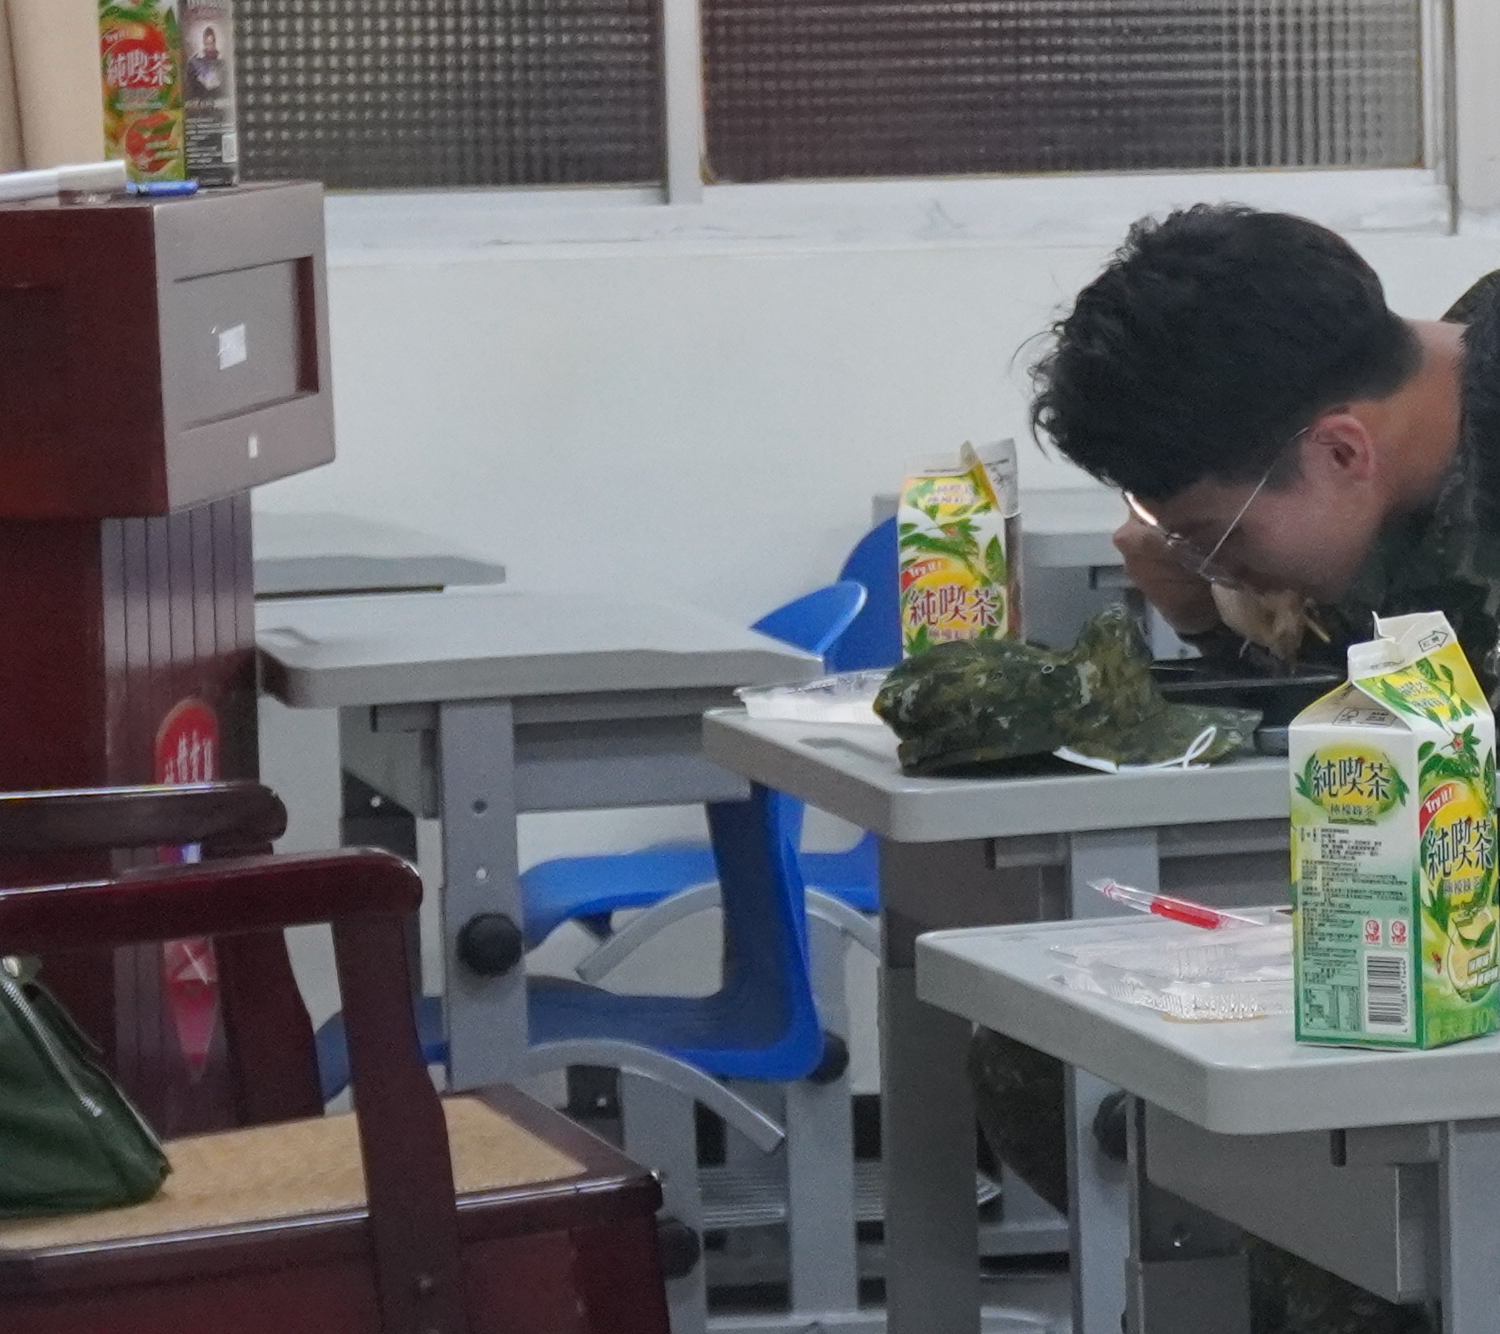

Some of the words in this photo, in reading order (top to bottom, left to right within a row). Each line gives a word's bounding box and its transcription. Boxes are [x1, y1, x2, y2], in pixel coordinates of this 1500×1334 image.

[107, 48, 174, 87] 純喫茶
[908, 585, 998, 627] 純喫茶
[1312, 756, 1391, 802] 純喫茶
[1425, 796, 1439, 814] Try
[1428, 817, 1493, 881] 純喫茶
